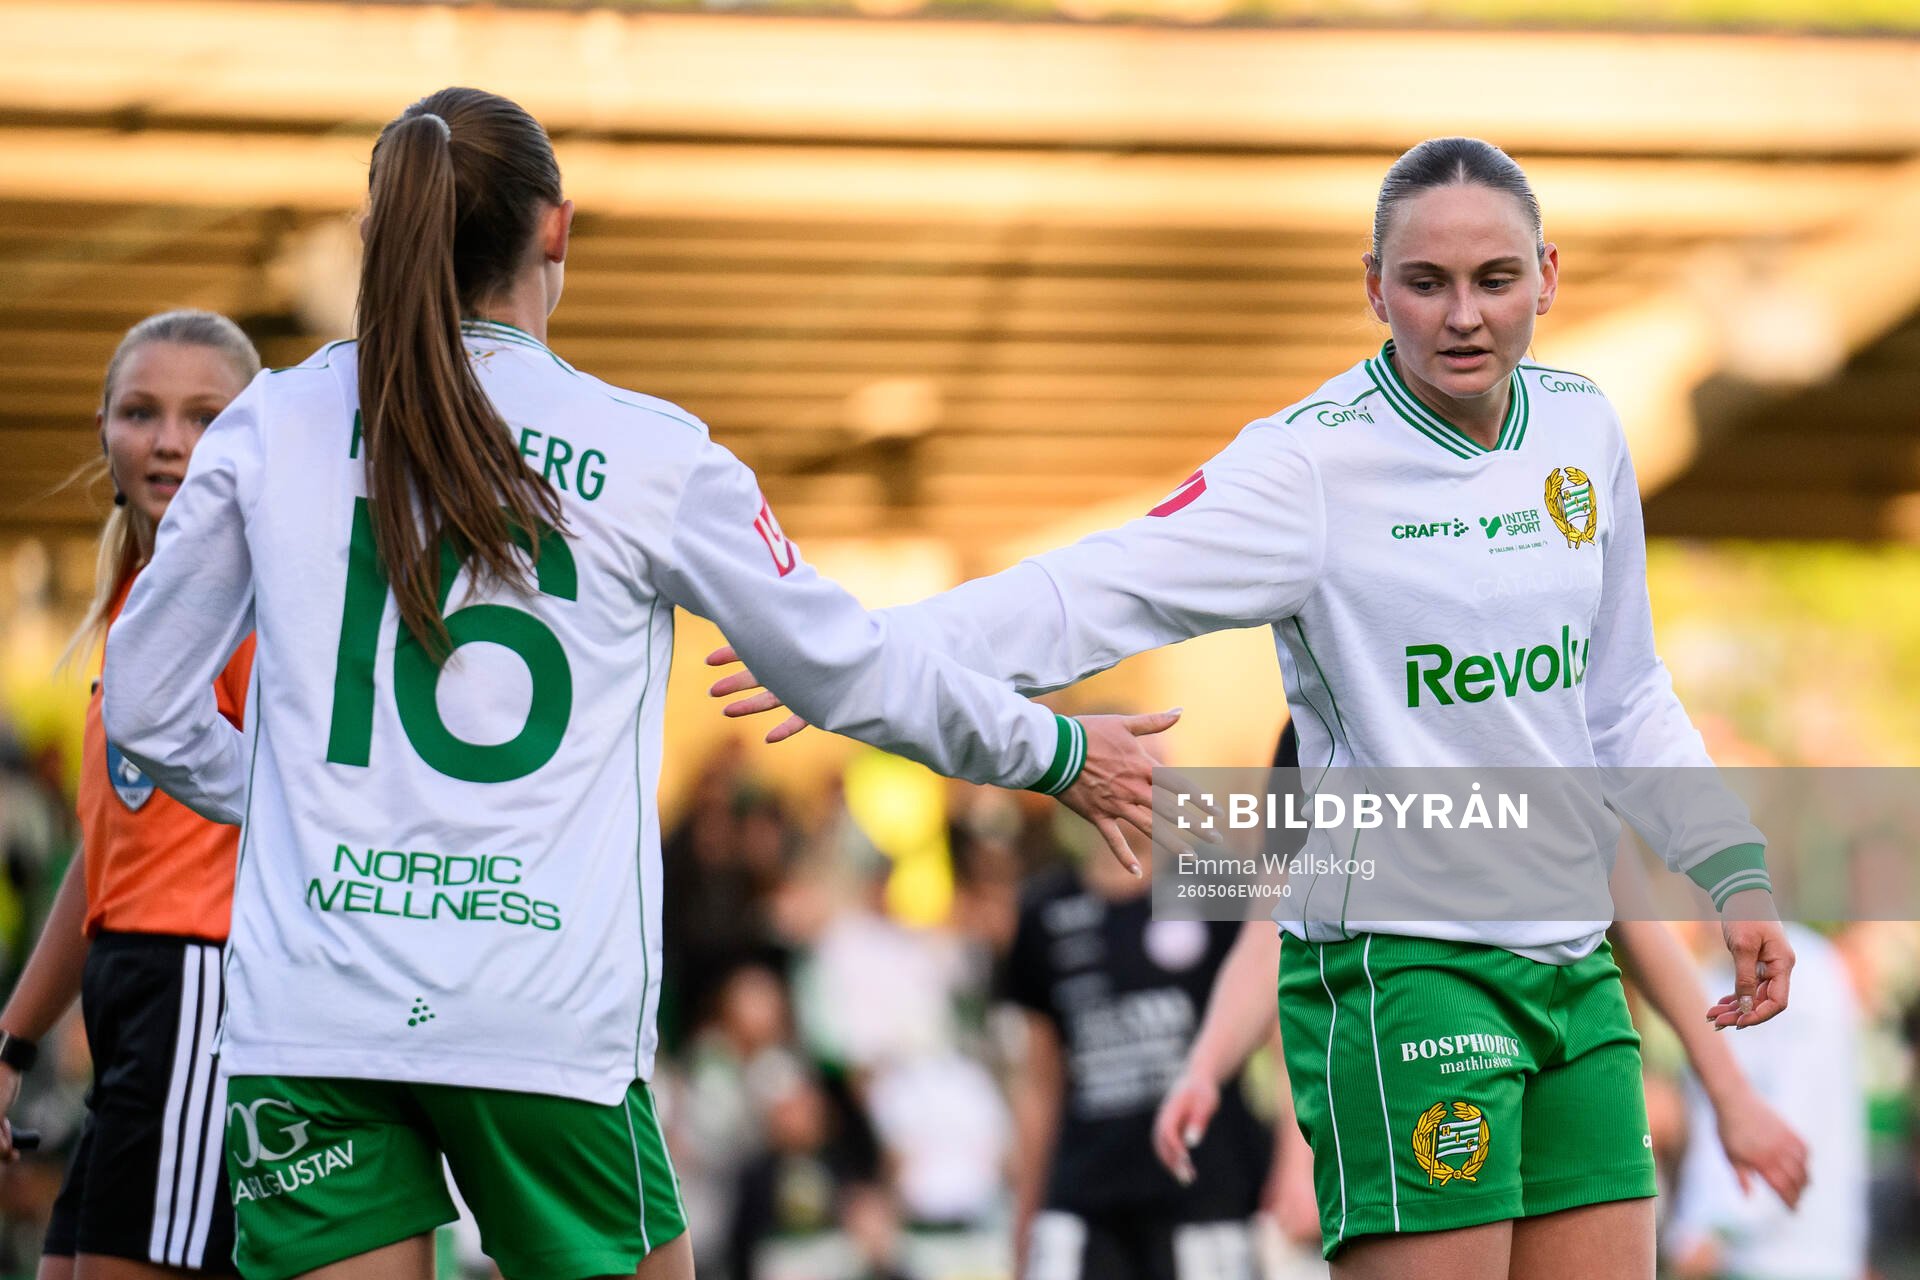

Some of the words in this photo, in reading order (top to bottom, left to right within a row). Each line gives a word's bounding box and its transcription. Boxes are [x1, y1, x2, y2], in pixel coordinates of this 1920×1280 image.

[1391, 522, 1452, 540] CRAFT
[1502, 509, 1539, 525] INTER
[1506, 520, 1541, 536] SPORT
[326, 496, 578, 784] 16
[333, 843, 523, 886] NORDIC
[304, 878, 562, 931] WELLNESS
[1400, 1033, 1519, 1062] BOSPHORUS
